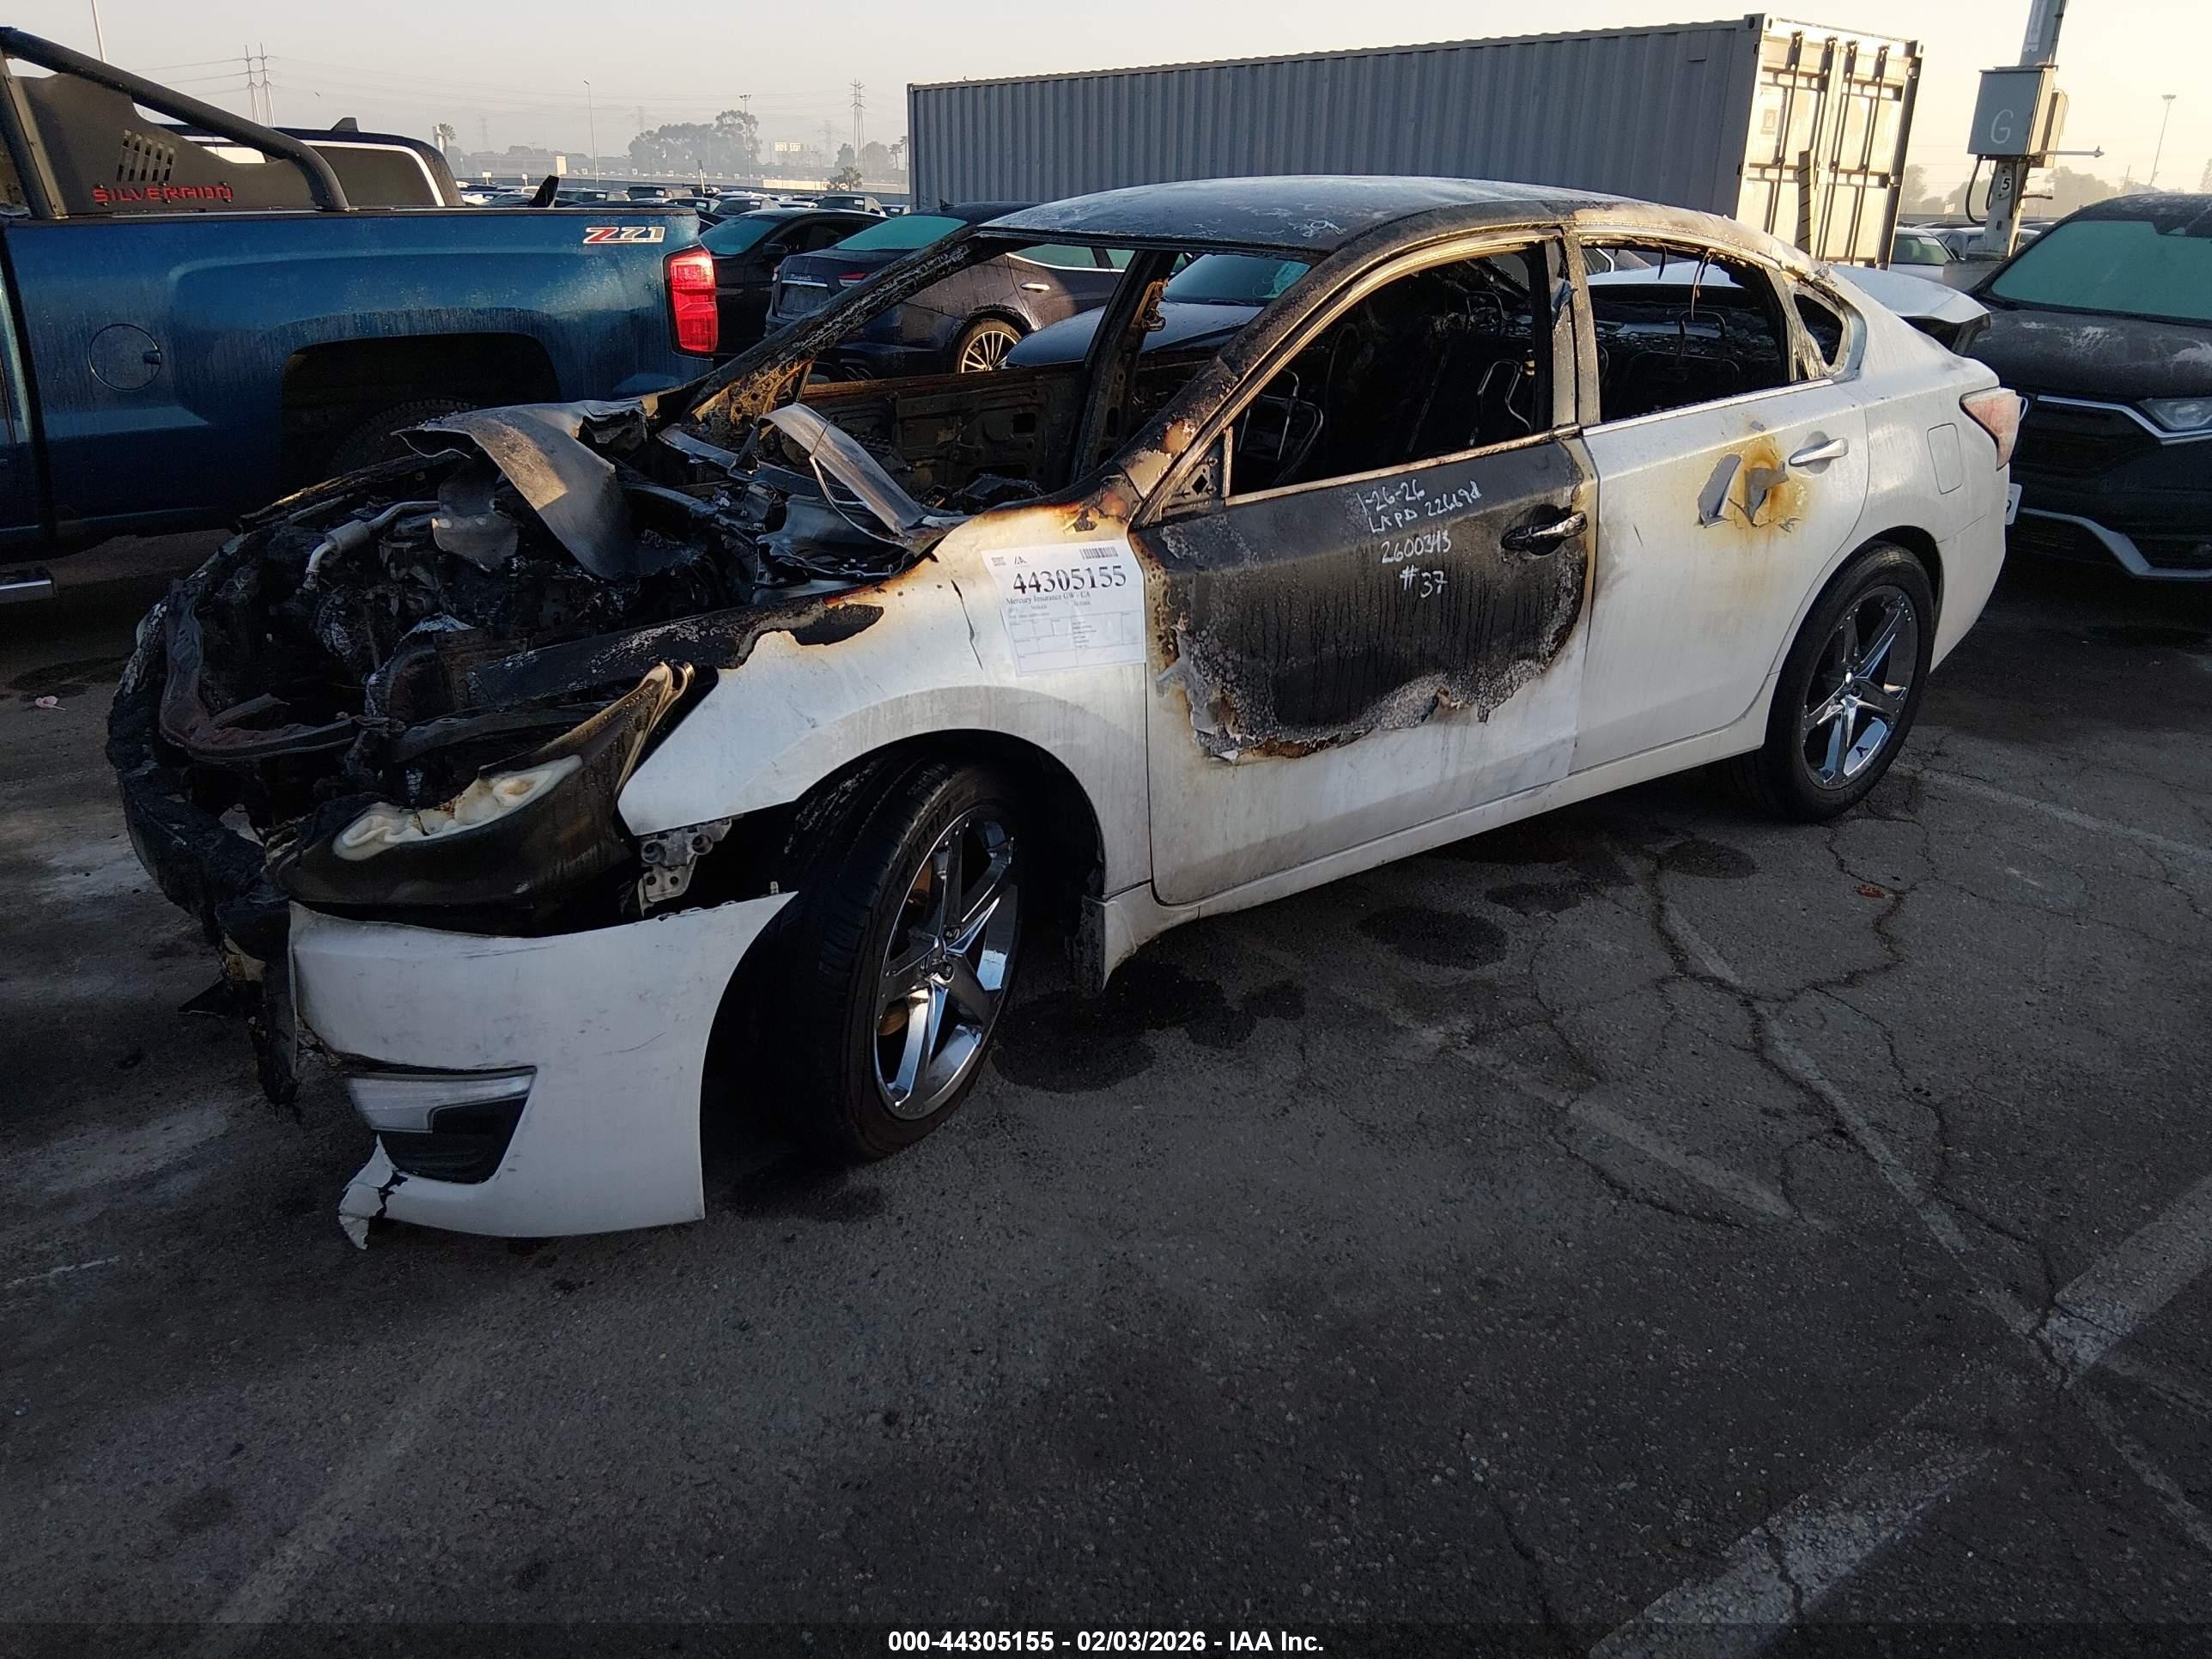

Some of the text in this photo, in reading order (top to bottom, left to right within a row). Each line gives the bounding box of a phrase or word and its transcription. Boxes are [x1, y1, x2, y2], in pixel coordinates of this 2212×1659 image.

[1990, 109, 2014, 144] G
[2002, 177, 2011, 191] 5
[92, 185, 234, 203] SILVERADO
[583, 226, 665, 243] Z71
[1013, 565, 1127, 594] 44305155
